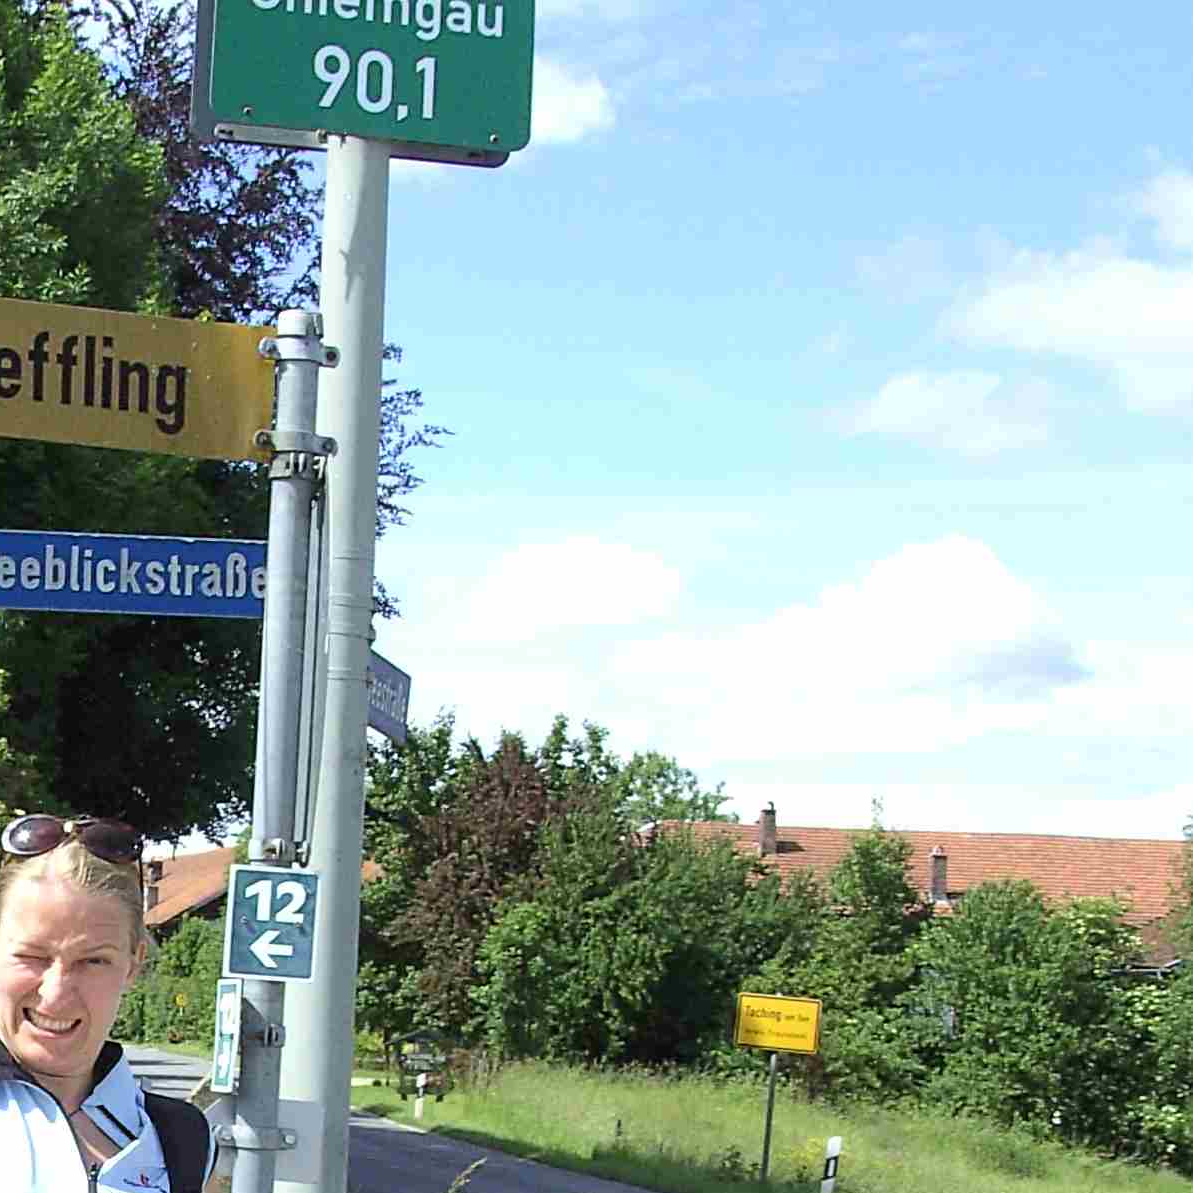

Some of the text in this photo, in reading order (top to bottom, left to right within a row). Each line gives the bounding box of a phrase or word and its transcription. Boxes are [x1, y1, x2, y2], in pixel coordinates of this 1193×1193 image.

[250, 0, 505, 41] emgau
[313, 44, 437, 121] 90,1
[244, 879, 307, 924] 12
